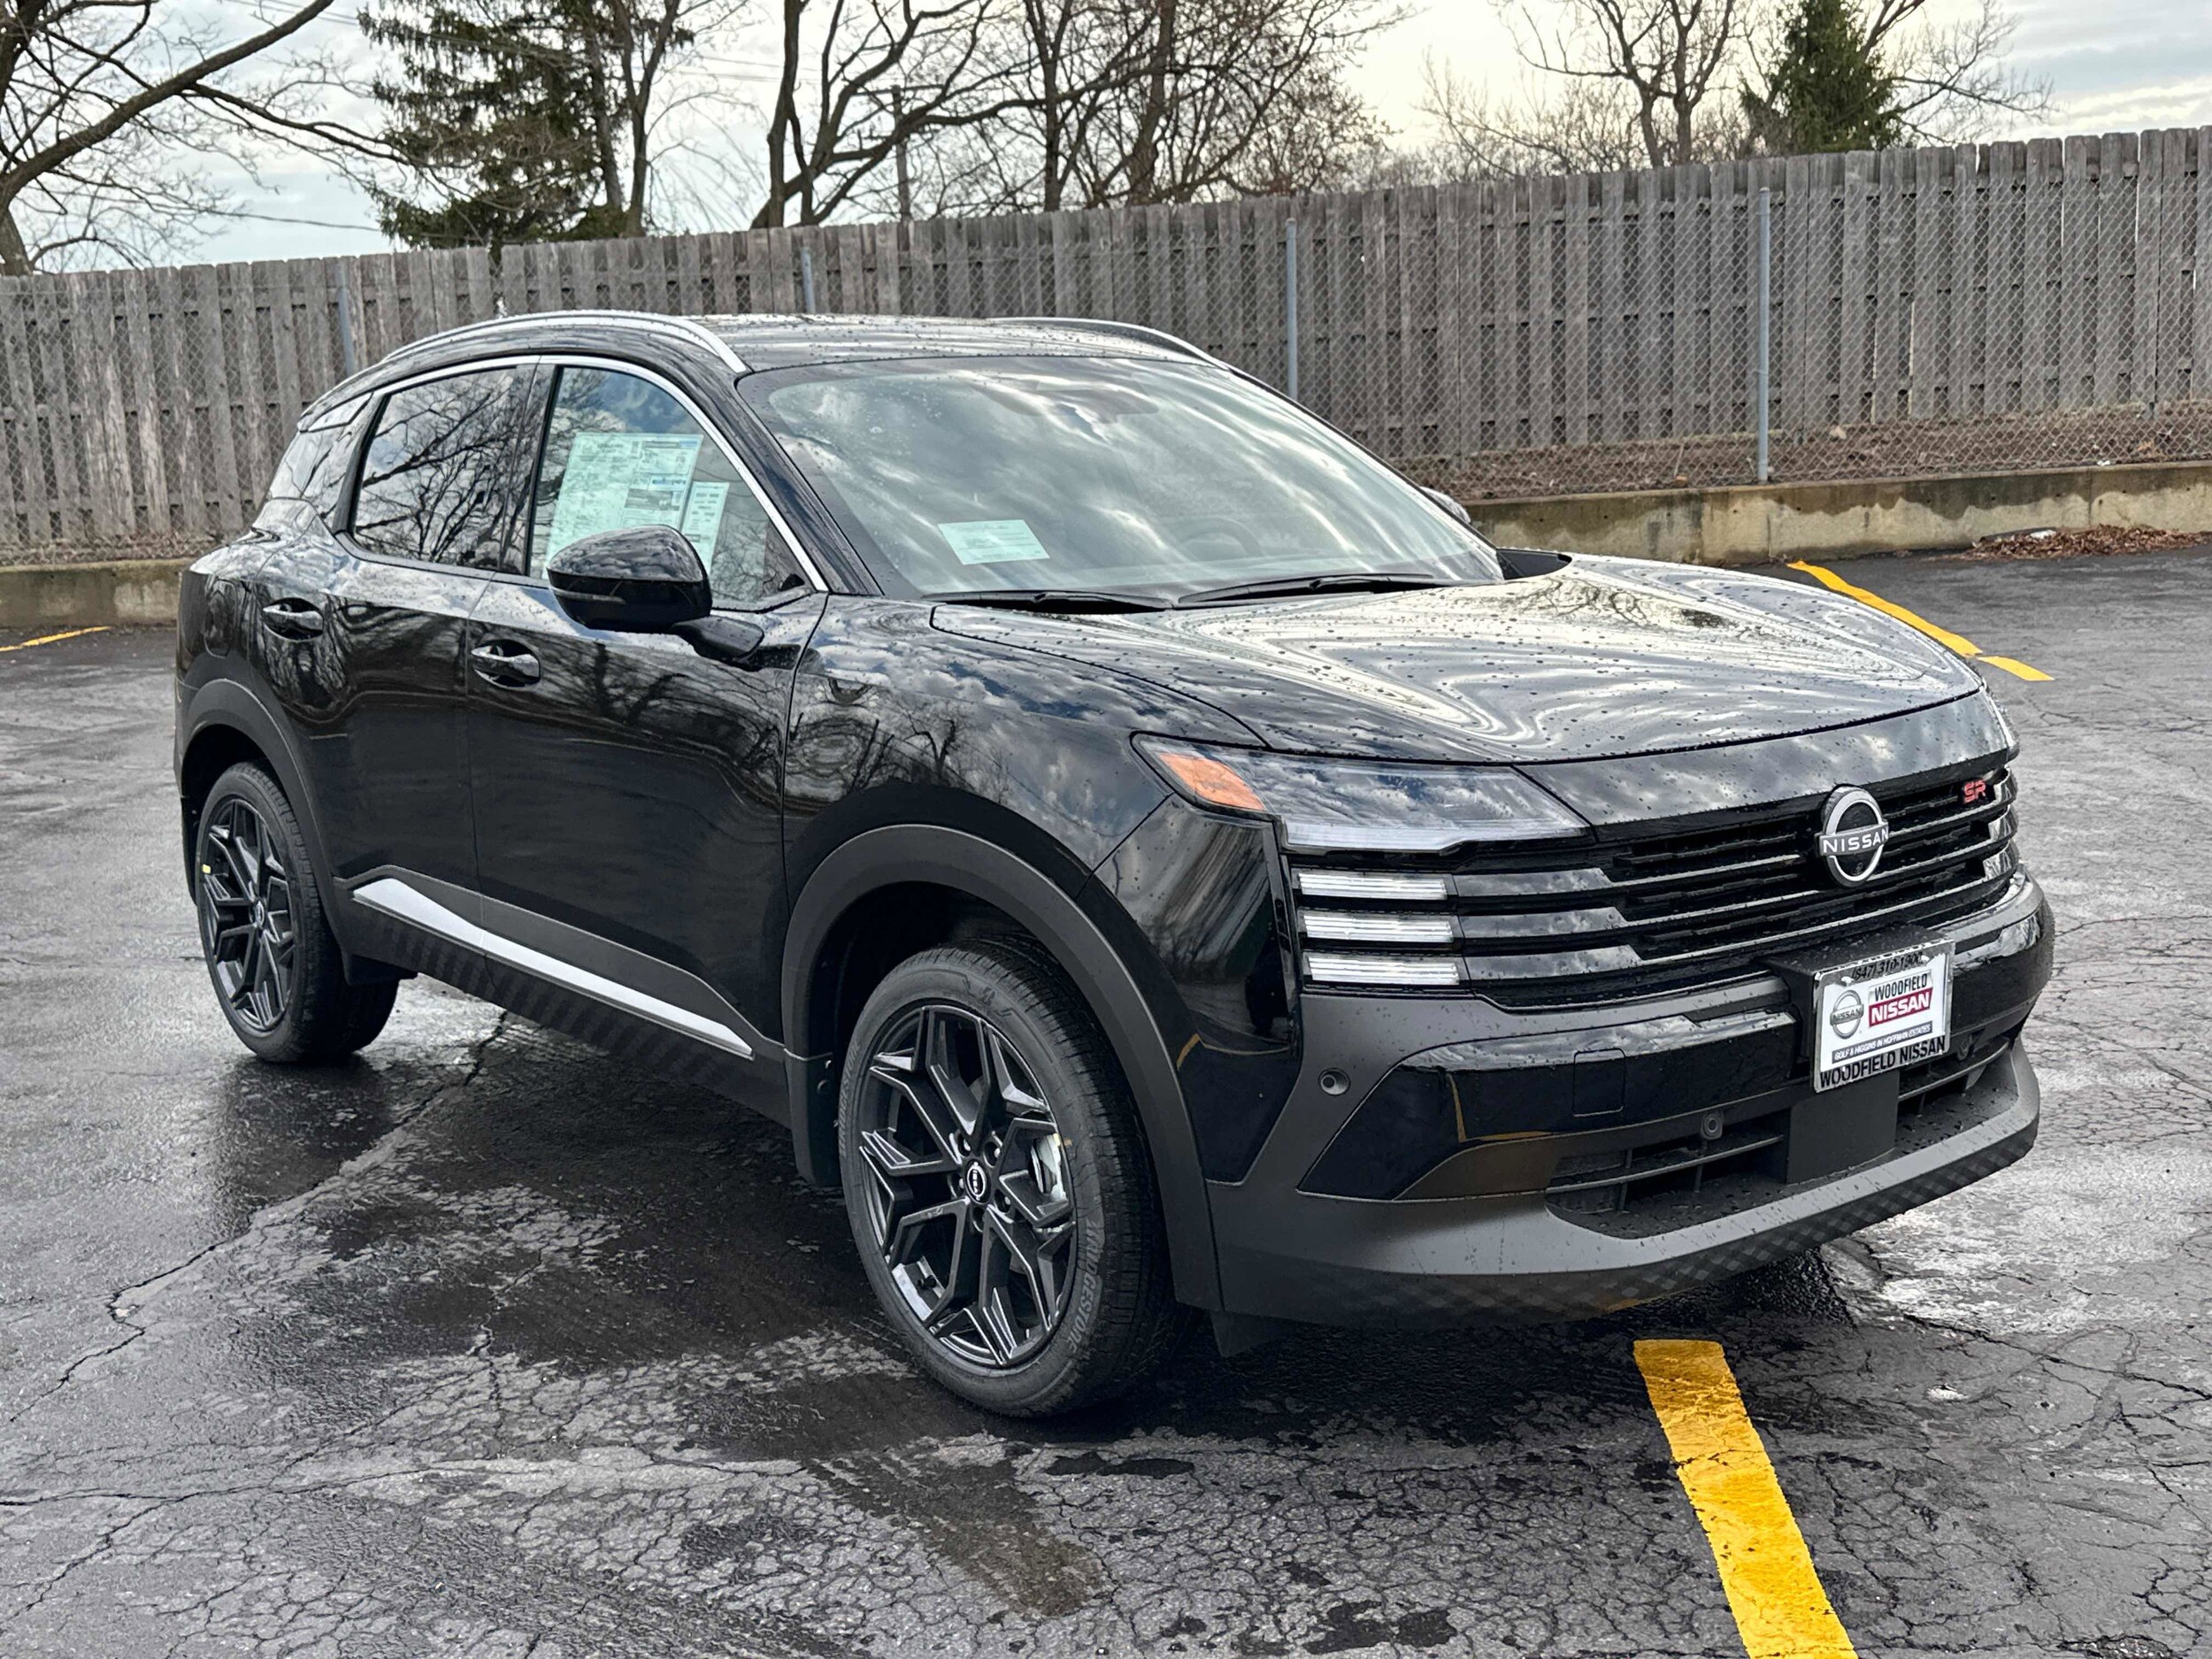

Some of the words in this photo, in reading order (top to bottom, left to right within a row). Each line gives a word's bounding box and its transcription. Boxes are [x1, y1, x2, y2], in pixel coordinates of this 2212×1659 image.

[1963, 780, 1986, 803] SR
[1823, 828, 1889, 853] NISSAN
[1874, 972, 1927, 1002] WOODFIELD
[1832, 1007, 1863, 1022] NISSAN
[1870, 992, 1930, 1024] NISSAN
[1820, 1049, 1896, 1088] WOODFIELD
[1900, 1037, 1946, 1063] NISSAN
